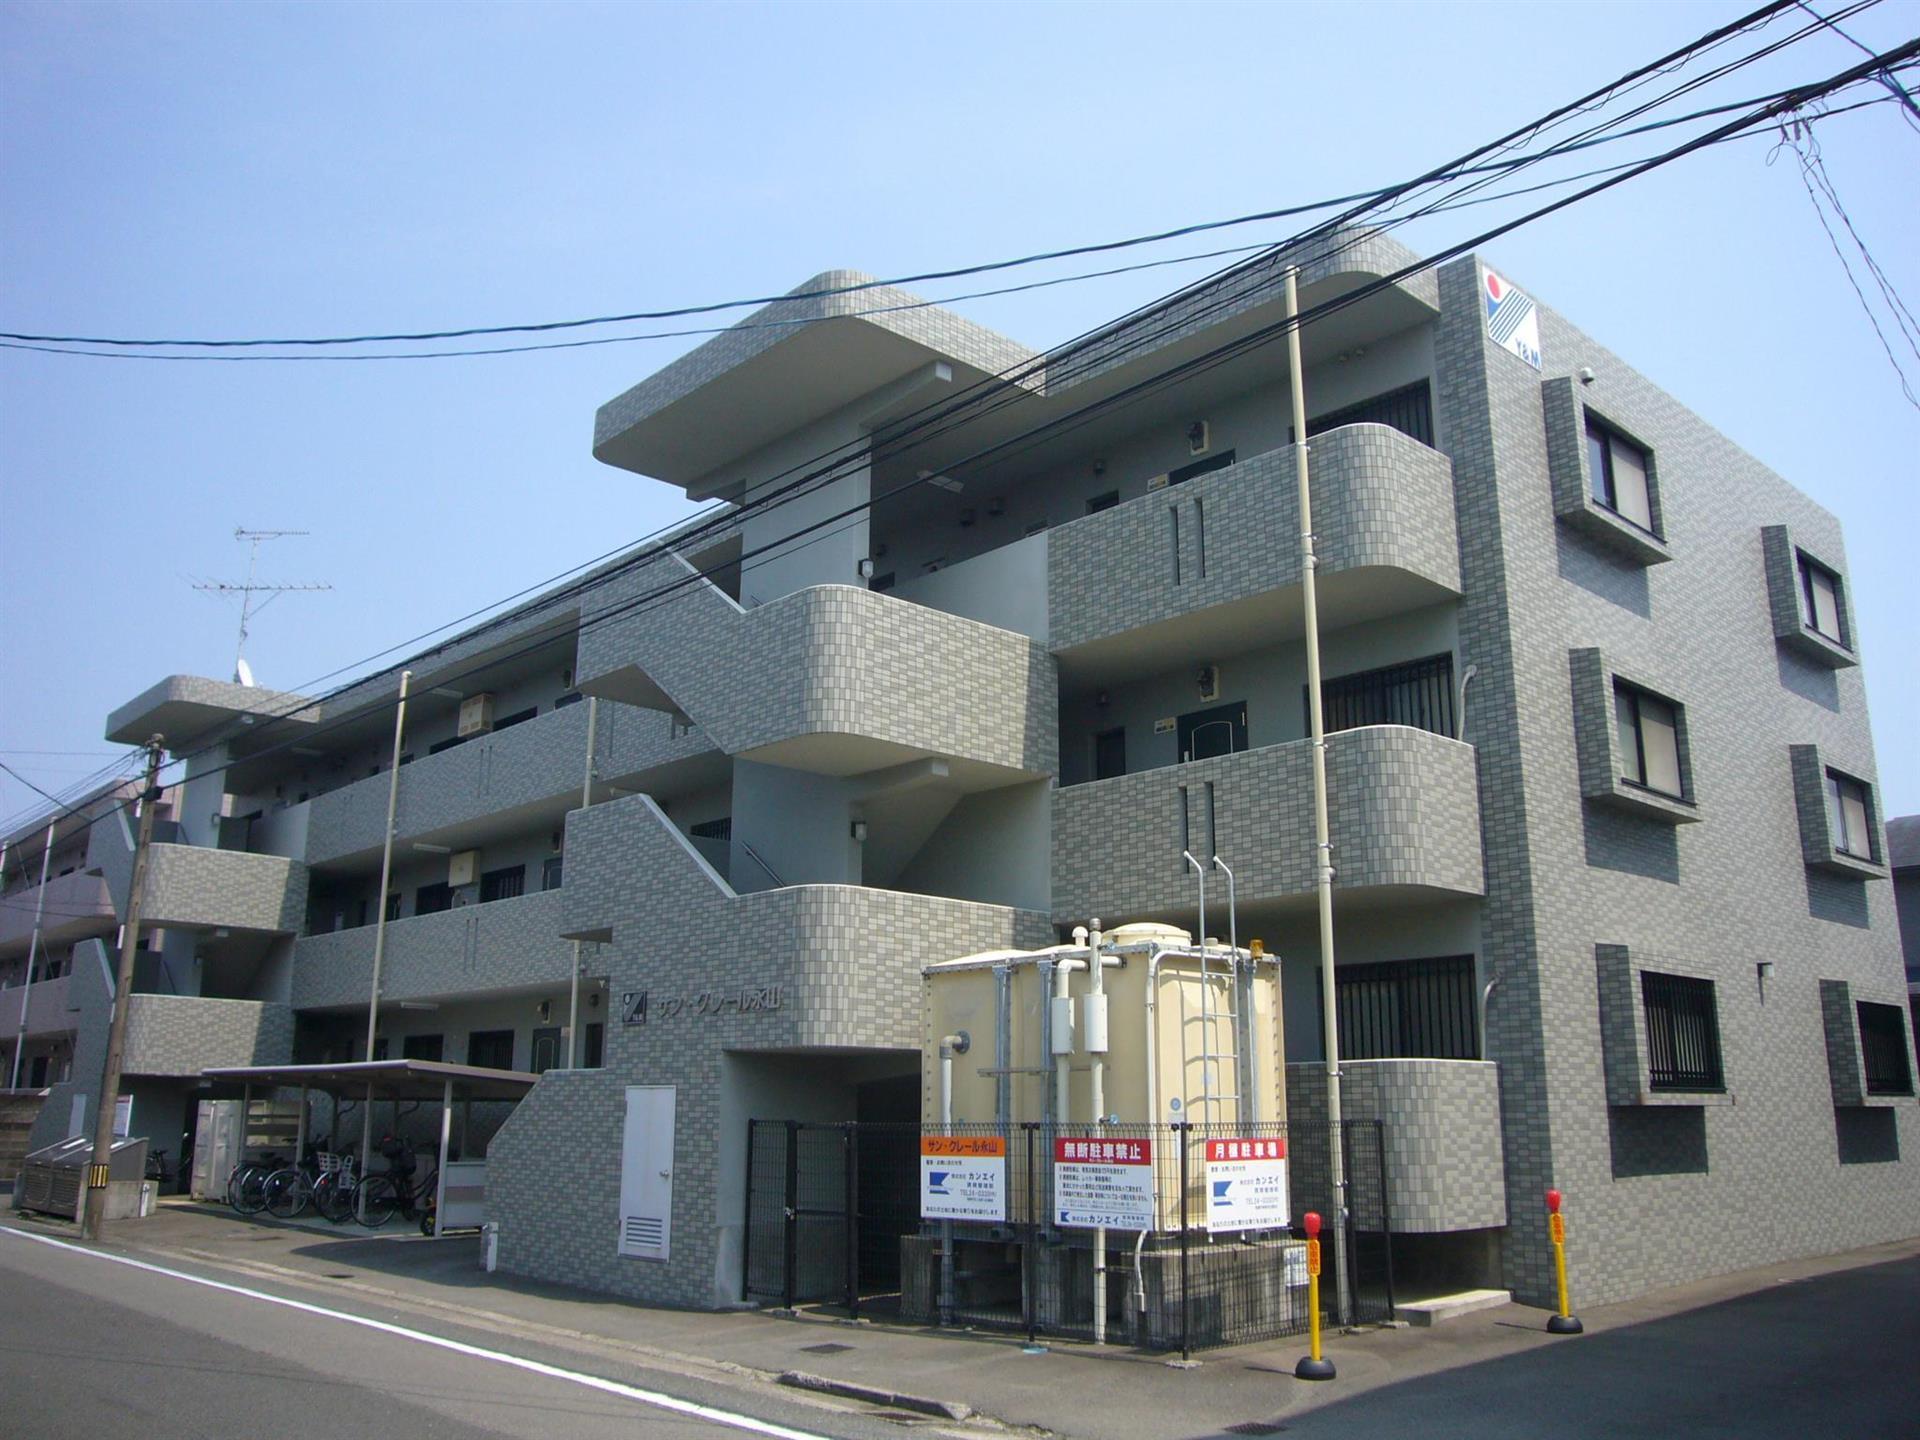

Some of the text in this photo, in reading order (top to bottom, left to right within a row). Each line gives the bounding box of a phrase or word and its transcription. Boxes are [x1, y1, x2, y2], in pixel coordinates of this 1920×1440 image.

[927, 1139, 998, 1153] サン・クレール永山
[1063, 1141, 1142, 1160] 無断駐車禁止
[1214, 1141, 1277, 1159] 月極駐車場
[968, 1171, 995, 1182] カンエイ
[1088, 1214, 1120, 1226] カンエイ
